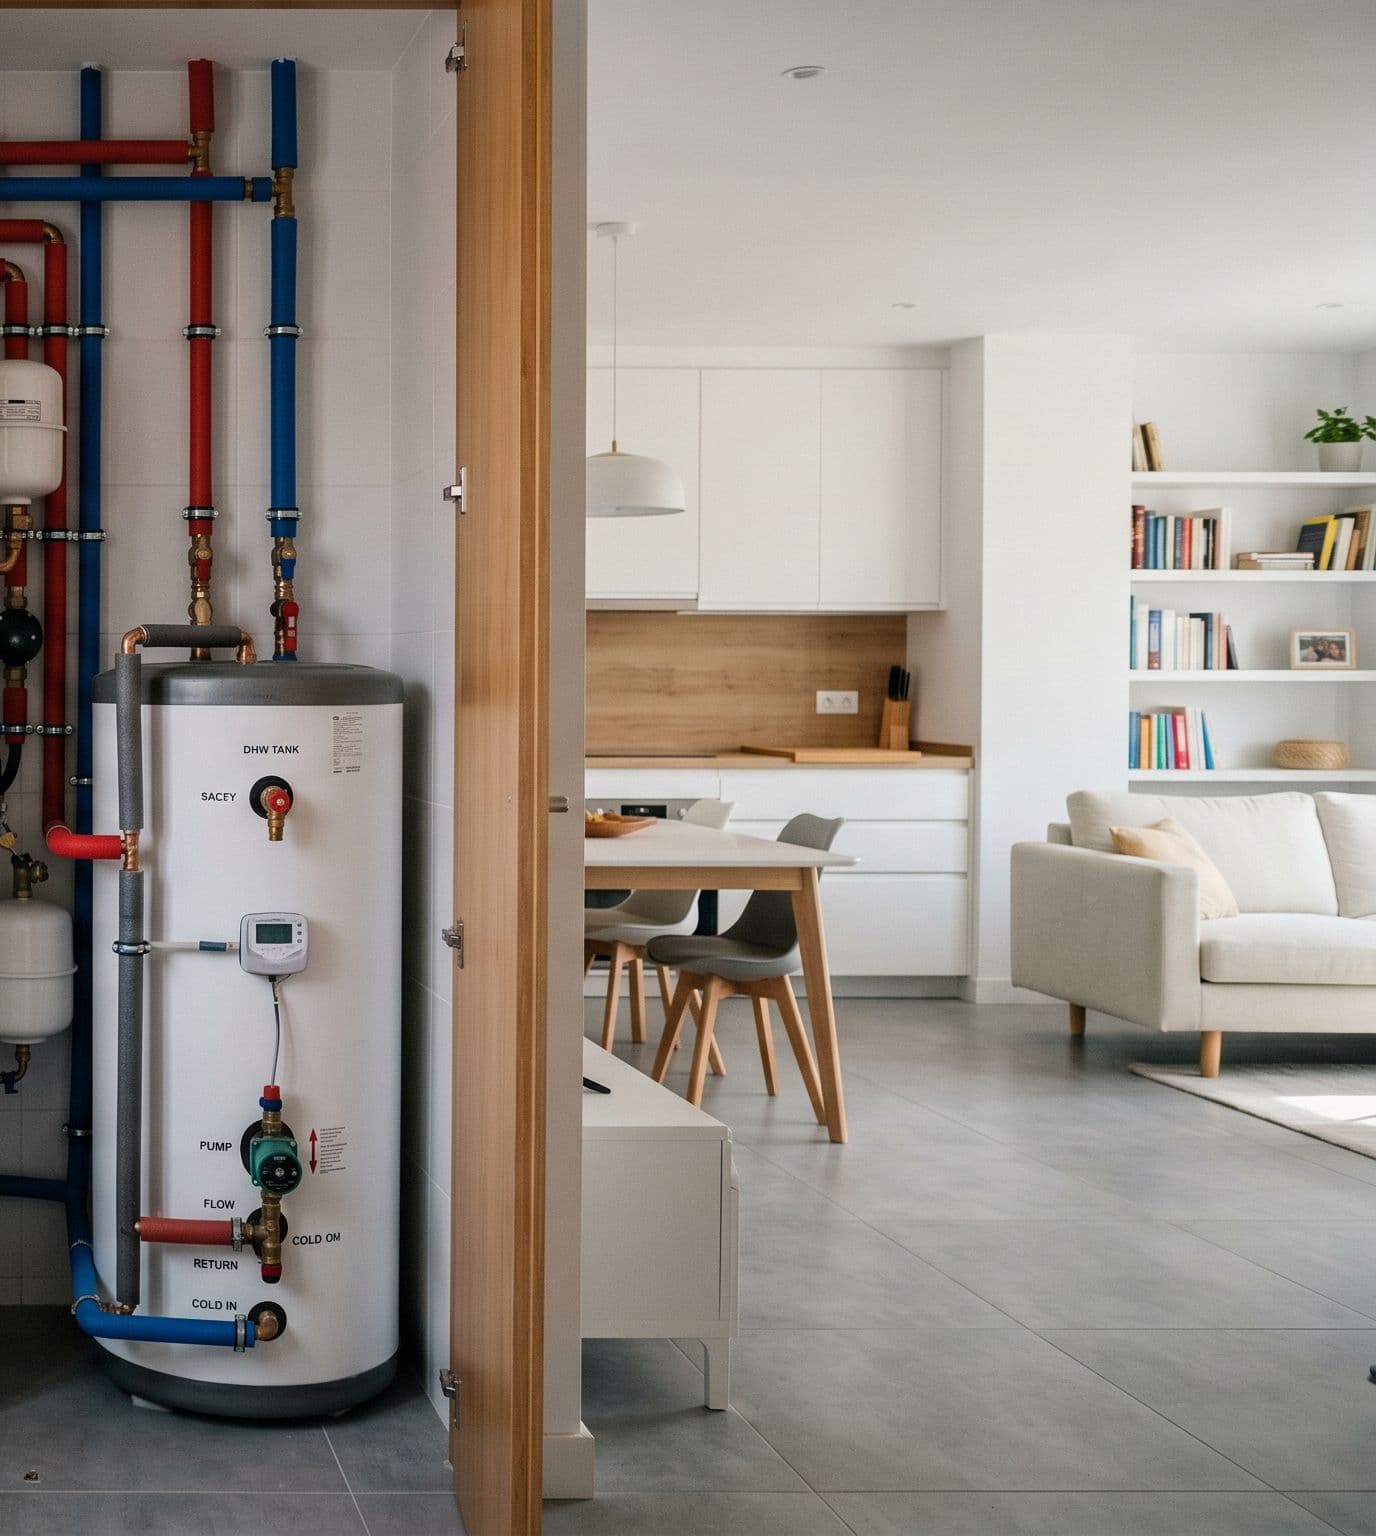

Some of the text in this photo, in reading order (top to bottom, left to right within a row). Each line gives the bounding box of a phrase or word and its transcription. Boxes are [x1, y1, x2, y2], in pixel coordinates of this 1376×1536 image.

[244, 745, 299, 754] DHW TANK
[201, 792, 236, 801] SACEY
[200, 1141, 232, 1152] PUMP
[204, 1199, 235, 1209] FLOW
[292, 1234, 322, 1245] COLD
[194, 1259, 238, 1270] RETURN
[192, 1299, 237, 1311] COLD IN
